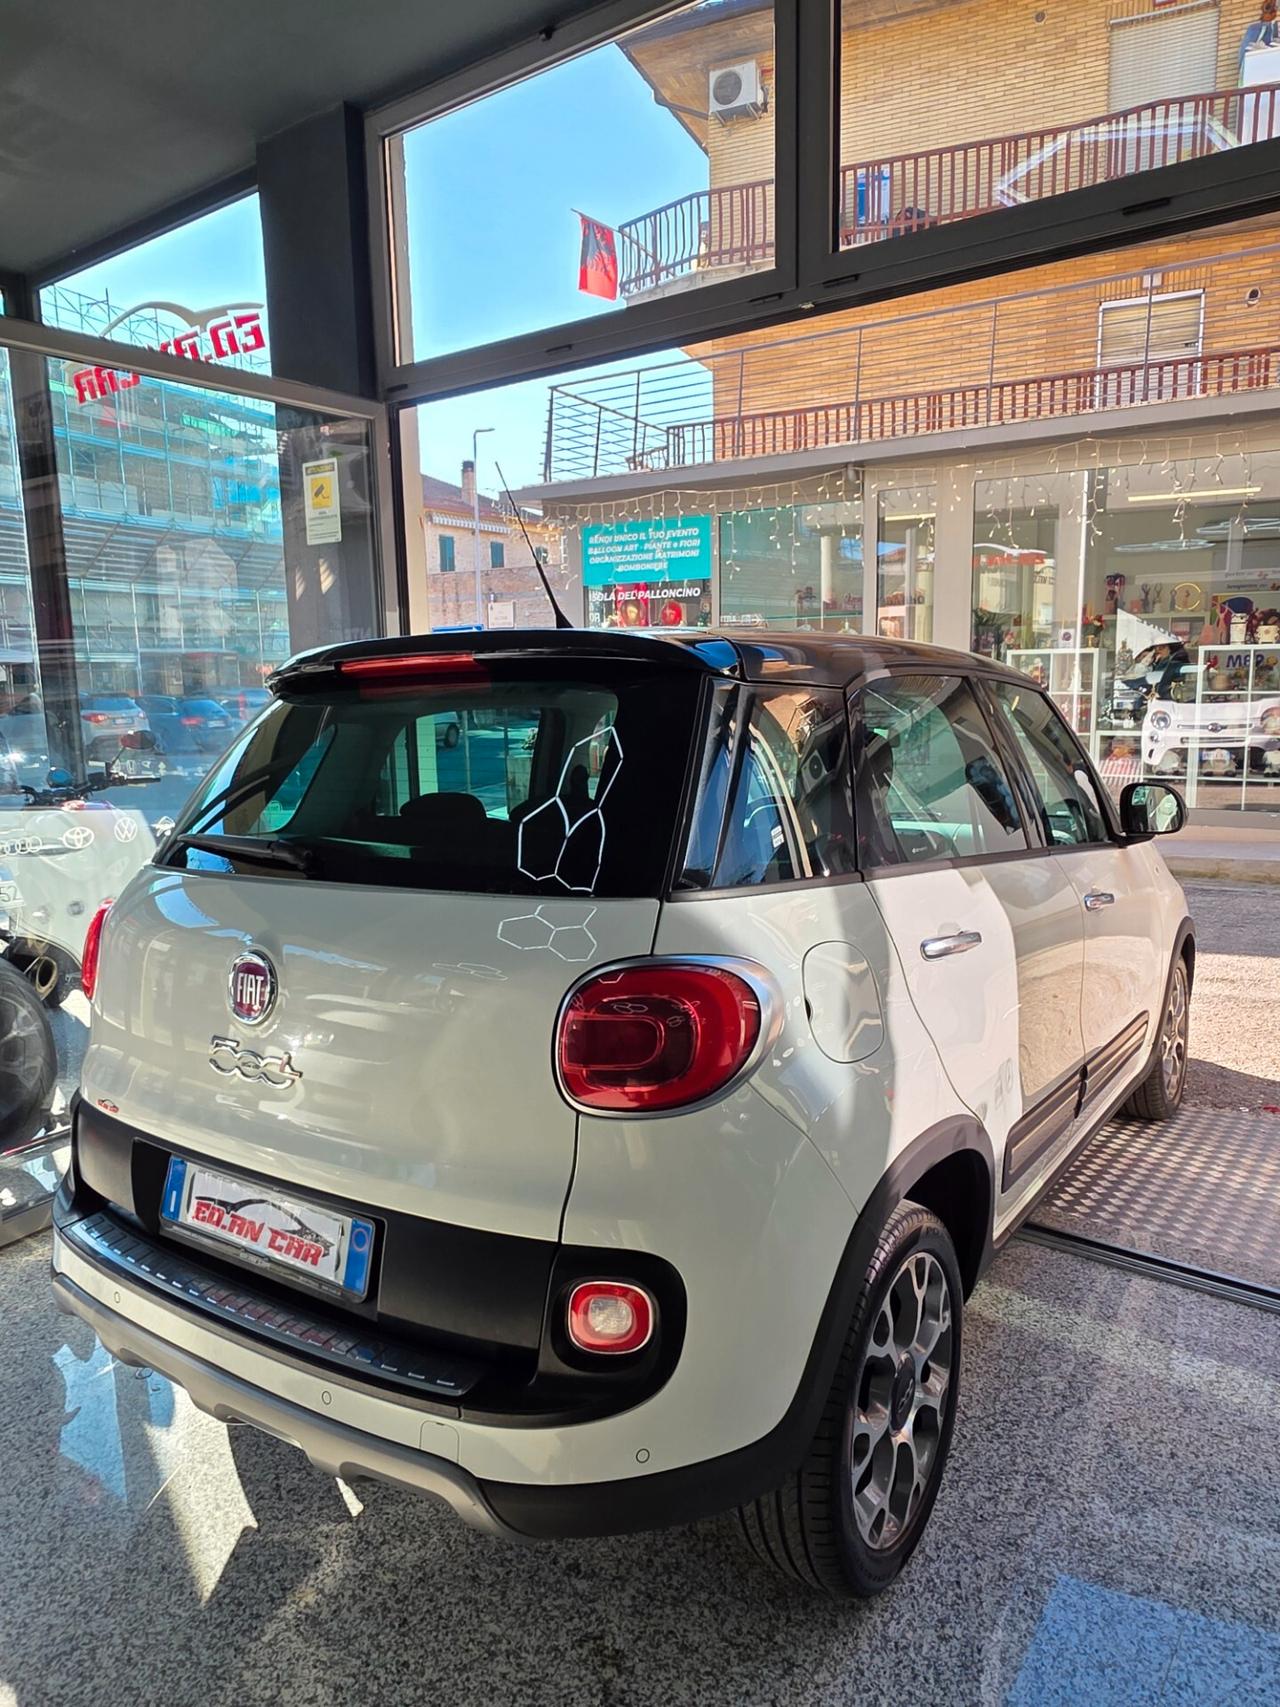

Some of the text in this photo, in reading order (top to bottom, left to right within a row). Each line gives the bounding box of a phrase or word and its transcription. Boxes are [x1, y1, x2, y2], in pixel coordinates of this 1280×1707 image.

[613, 532, 638, 542] UNICO
[648, 530, 665, 539] TUO
[666, 527, 699, 540] EVENTO
[588, 546, 622, 555] BALLOON
[623, 543, 639, 552] ART
[644, 541, 671, 551] PIANTE
[679, 538, 700, 548] FIORI
[589, 549, 700, 564] ORGANIZZAZIONE MATRIMONI
[617, 589, 636, 600] DEL
[637, 587, 701, 599] PALLONCINO
[236, 972, 264, 1008] FIAT
[191, 1200, 323, 1266] ED.AN CAR
